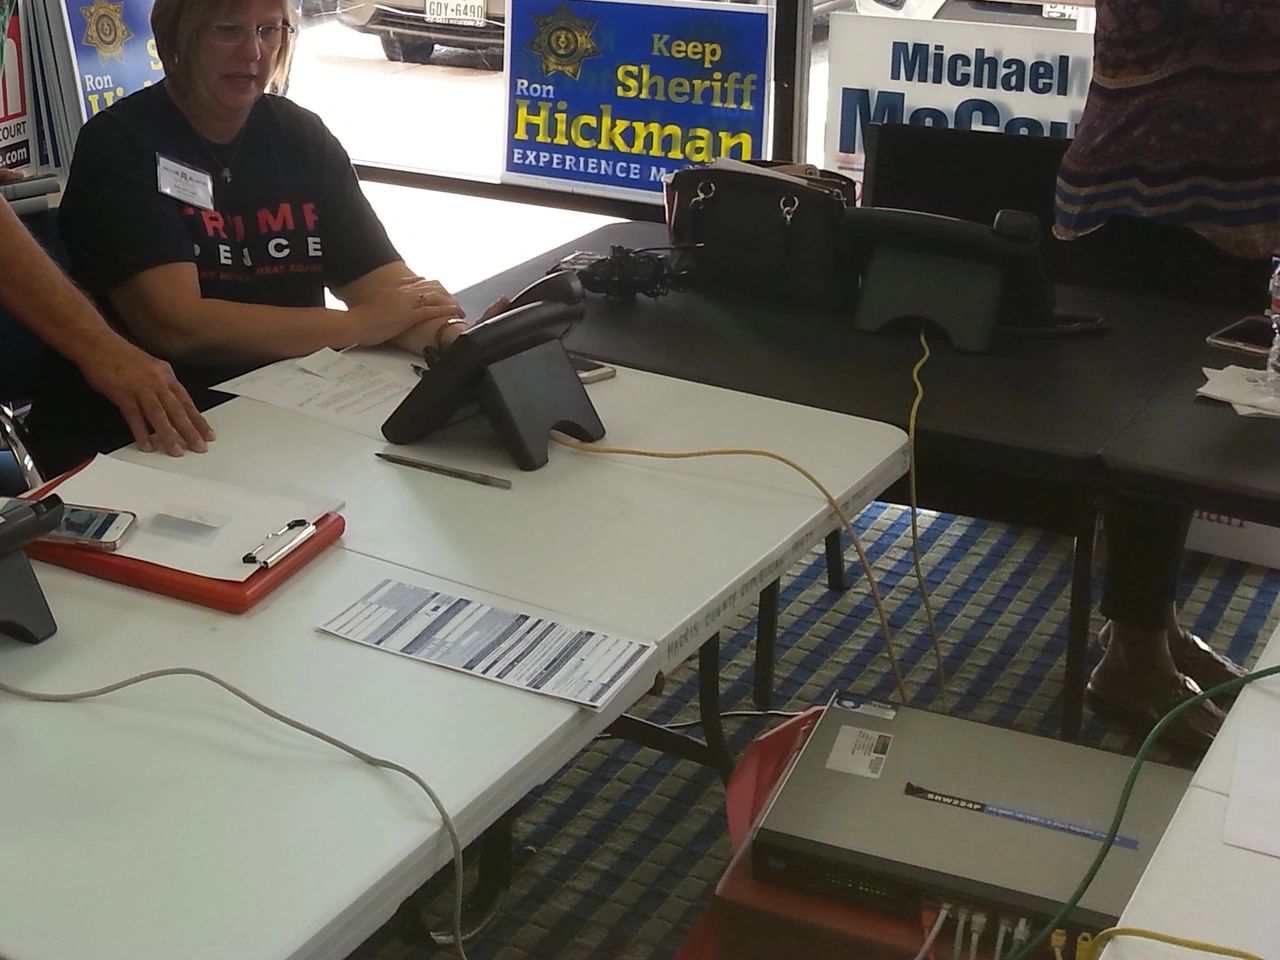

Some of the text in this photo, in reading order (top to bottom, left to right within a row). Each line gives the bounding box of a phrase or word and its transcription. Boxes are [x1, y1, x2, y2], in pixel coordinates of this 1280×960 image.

[651, 33, 721, 68] Keep
[85, 73, 113, 91] Ron
[890, 41, 1070, 96] Michael
[515, 78, 555, 99] Ron
[616, 64, 758, 110] Sheriff
[513, 99, 753, 163] Hickman
[512, 148, 641, 180] EXPERIENCE
